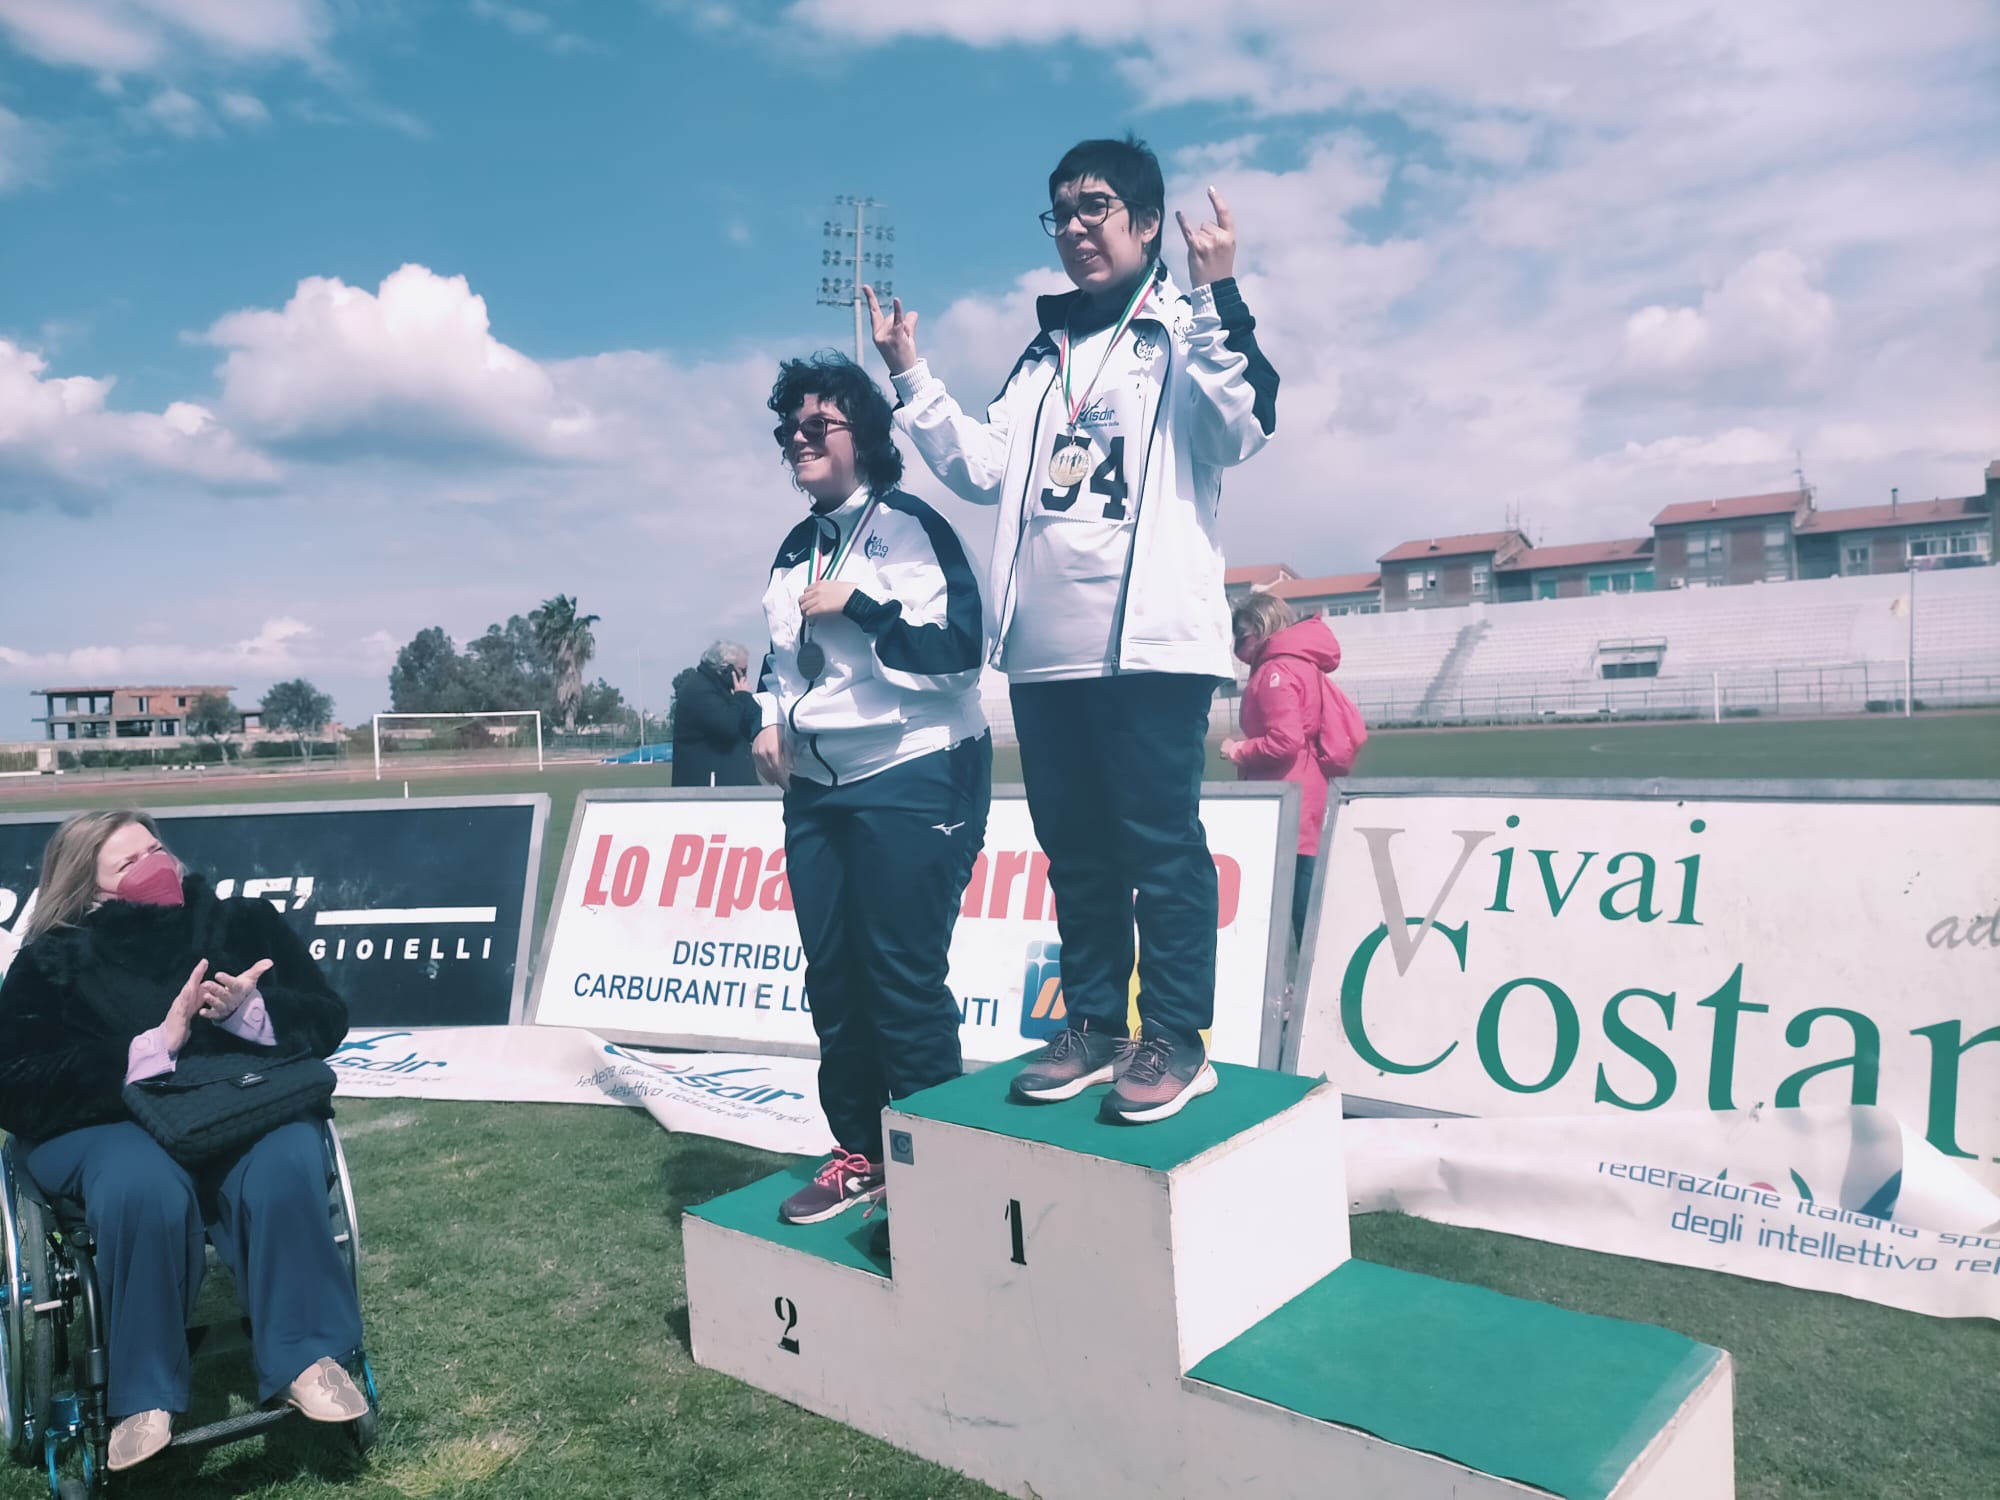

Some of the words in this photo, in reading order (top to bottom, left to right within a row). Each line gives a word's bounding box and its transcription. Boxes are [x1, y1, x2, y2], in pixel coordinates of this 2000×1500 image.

[583, 834, 650, 907] Lo
[658, 834, 794, 918] Pipa
[1353, 815, 1706, 977] Vivai
[309, 937, 492, 961] GIOIELLI
[672, 940, 806, 972] DISTRIBU
[574, 972, 747, 1008] CARBURANTI
[754, 983, 773, 1010] E
[1004, 1199, 1027, 1266] 1
[1671, 1205, 1744, 1244] degli
[1758, 1218, 1938, 1272] intellettivo
[774, 1296, 801, 1355] 2
